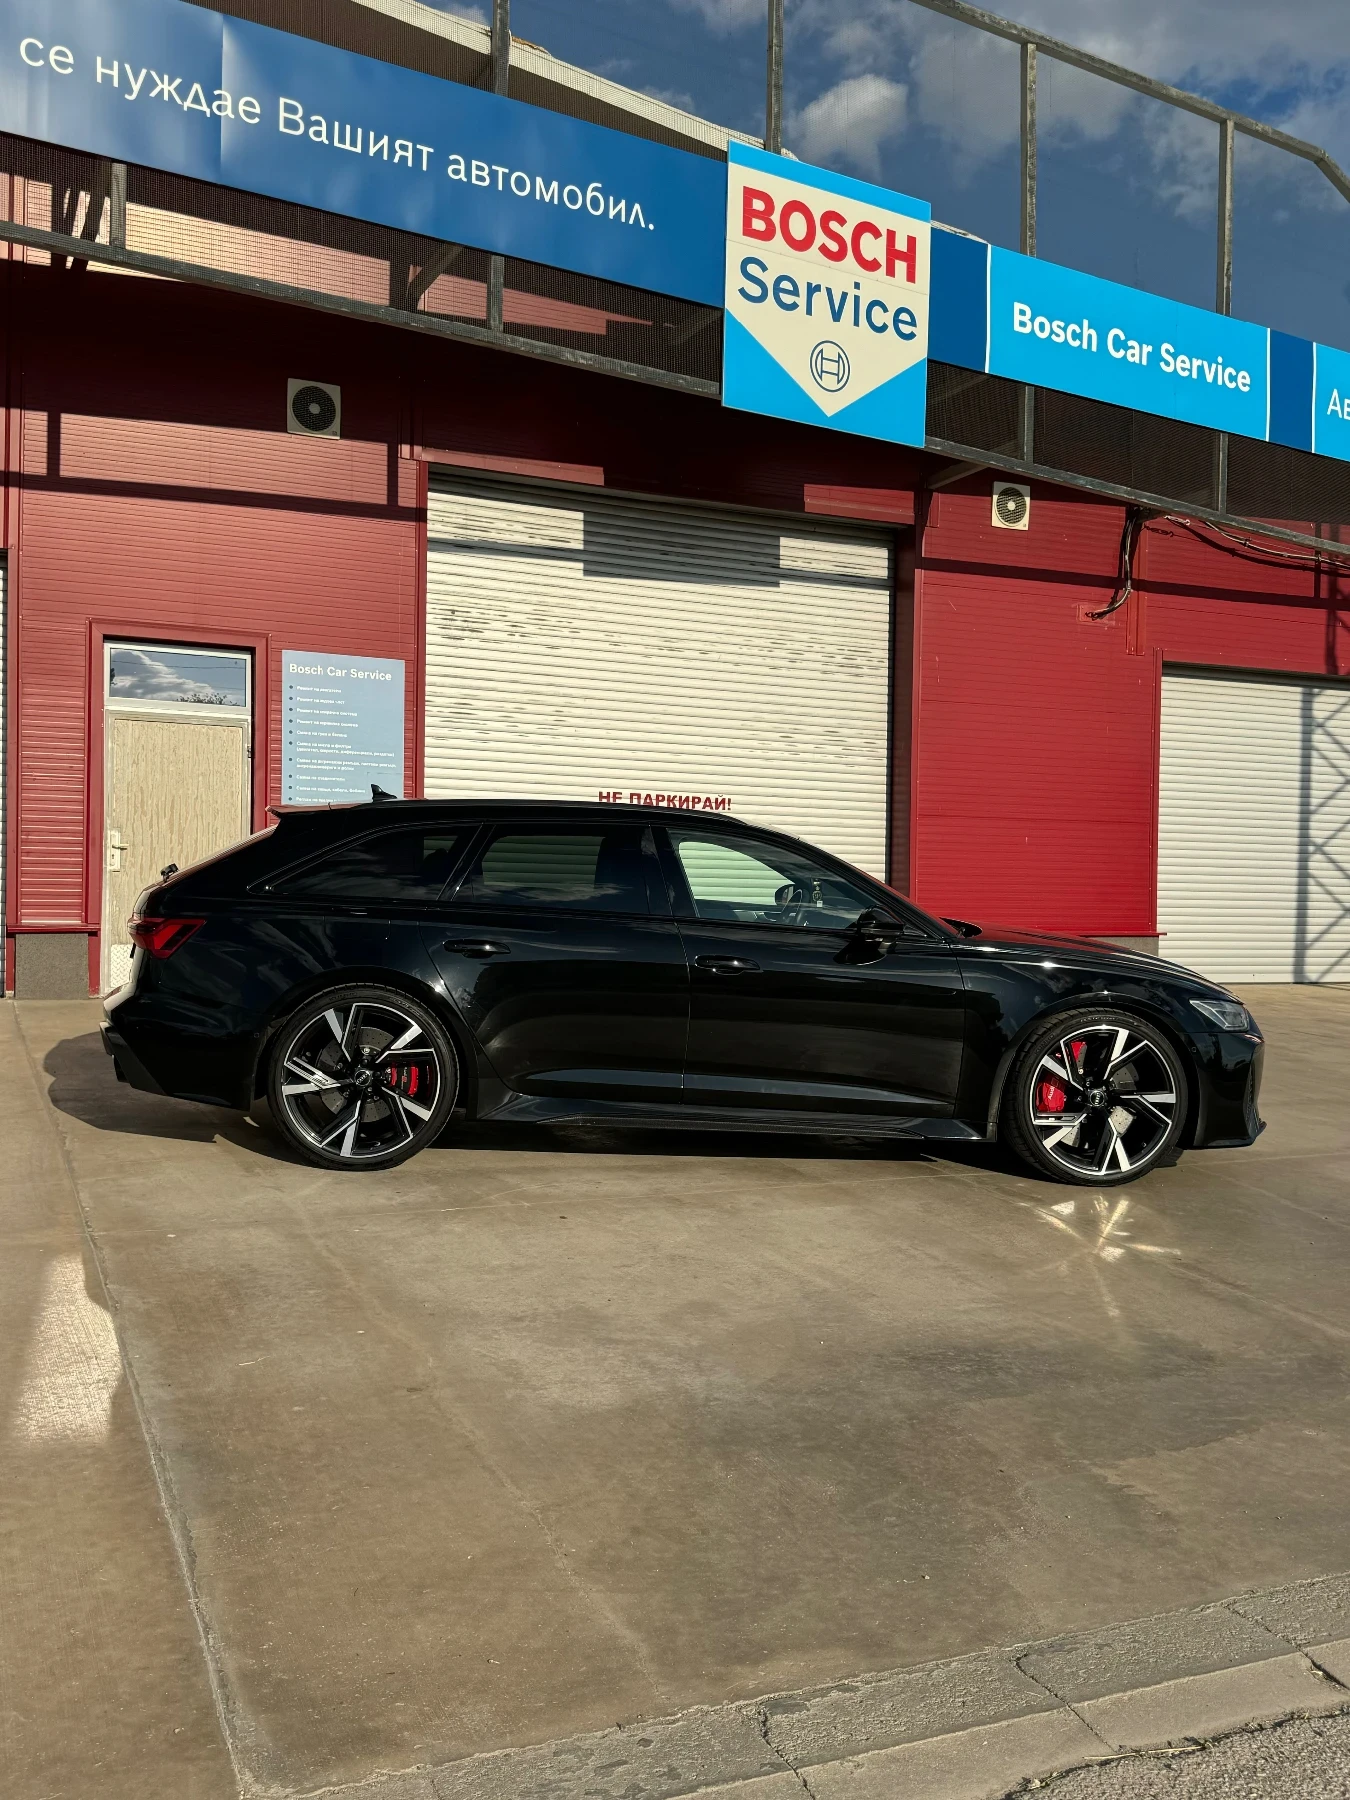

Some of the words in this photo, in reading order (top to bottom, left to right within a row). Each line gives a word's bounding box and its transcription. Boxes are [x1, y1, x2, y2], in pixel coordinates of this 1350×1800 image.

[19, 37, 74, 75] се
[96, 55, 261, 124] нуждае
[279, 97, 434, 171] Вашият
[447, 154, 655, 230] автомобил.
[742, 186, 917, 284] BOSCH
[737, 256, 918, 342] Service
[1013, 301, 1098, 352] Bosch
[1107, 327, 1153, 366] Car
[1159, 342, 1251, 393] Service
[289, 663, 324, 676] Bosch
[326, 666, 348, 677] Car
[350, 668, 392, 681] Service
[629, 793, 732, 811] ПАРКИРАЙ!
